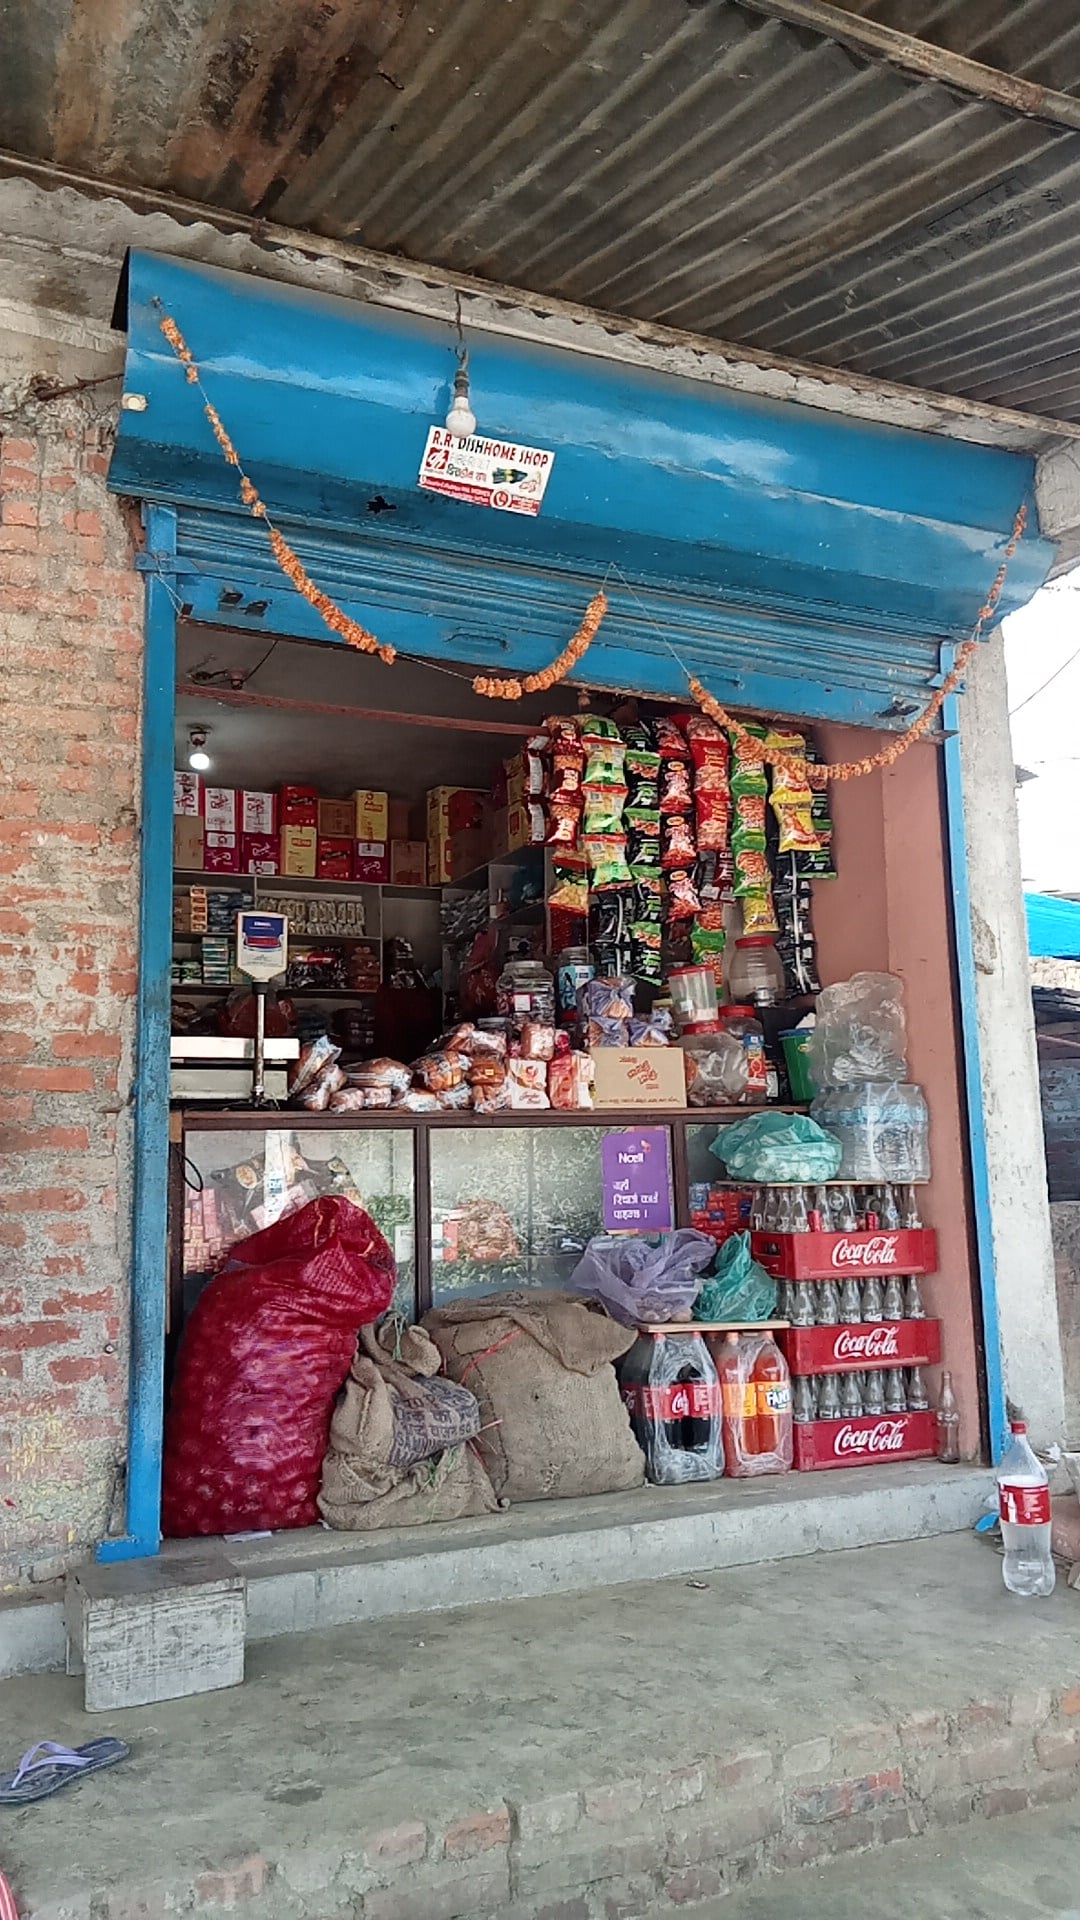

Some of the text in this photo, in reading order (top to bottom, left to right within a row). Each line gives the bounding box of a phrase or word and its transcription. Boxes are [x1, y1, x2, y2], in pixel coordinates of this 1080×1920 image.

[432, 430, 548, 467] R.R. DISHHOME SHOP
[618, 1152, 645, 1163] Ncell
